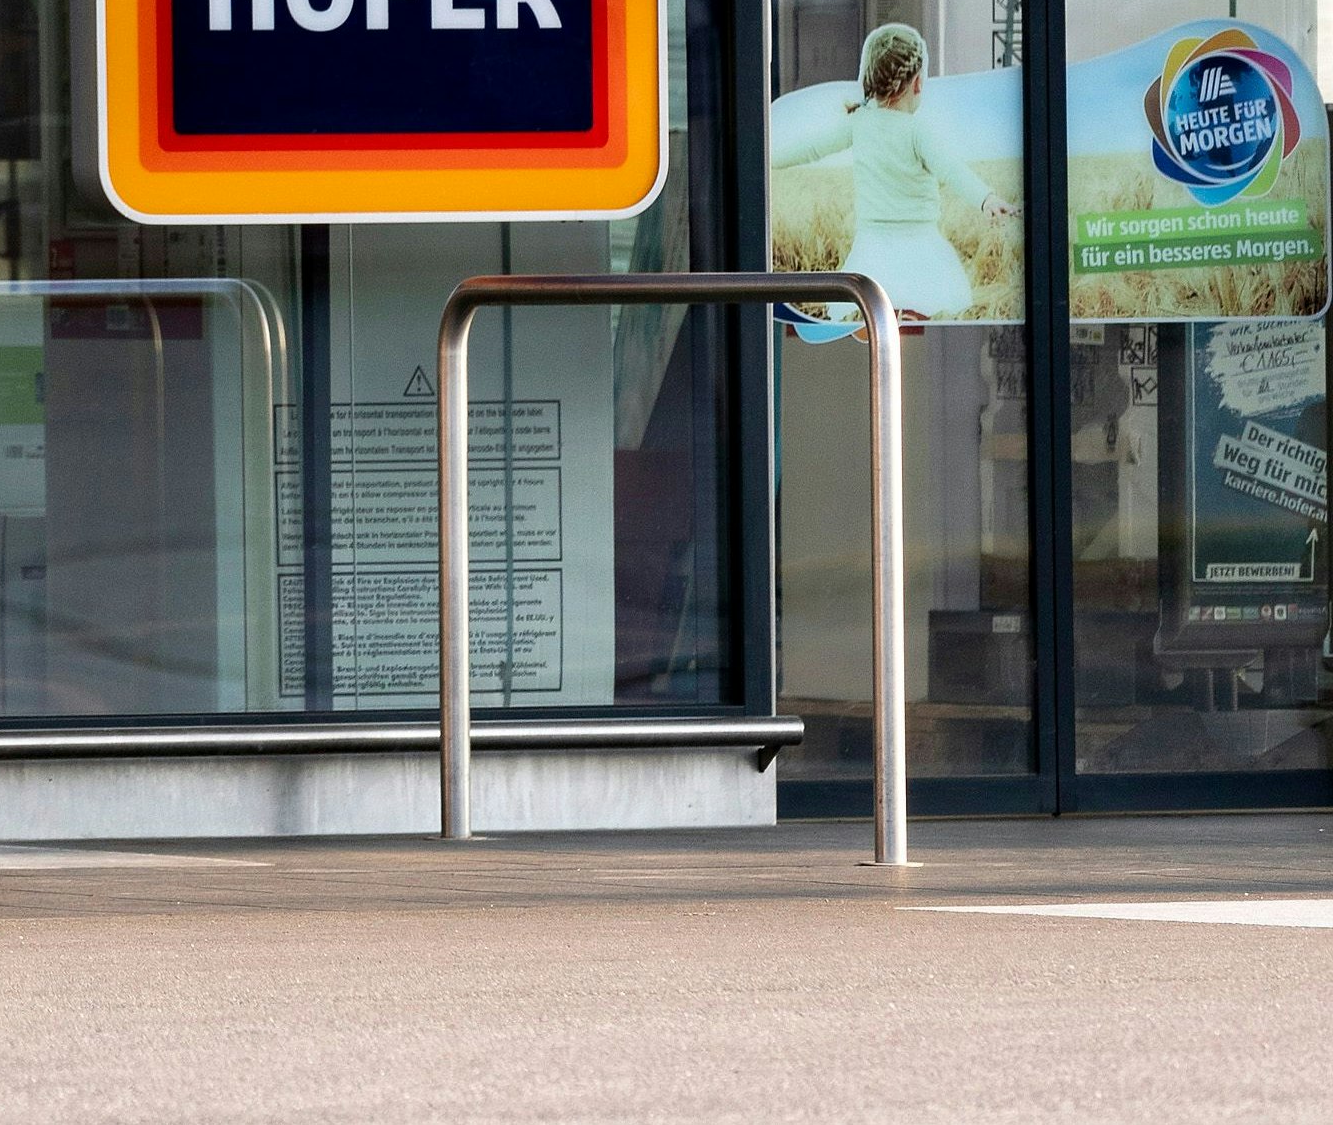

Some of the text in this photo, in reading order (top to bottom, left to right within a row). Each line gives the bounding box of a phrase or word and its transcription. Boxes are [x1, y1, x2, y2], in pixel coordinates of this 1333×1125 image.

[1175, 98, 1268, 131] HEUTE FÜR
[1179, 118, 1273, 156] MORGEN
[1086, 207, 1300, 239] Wir sorgen schon heute
[1081, 237, 1316, 268] für ein besseres Morgen.
[1247, 426, 1327, 475] Der richtig
[1223, 443, 1327, 499] Weg für mic
